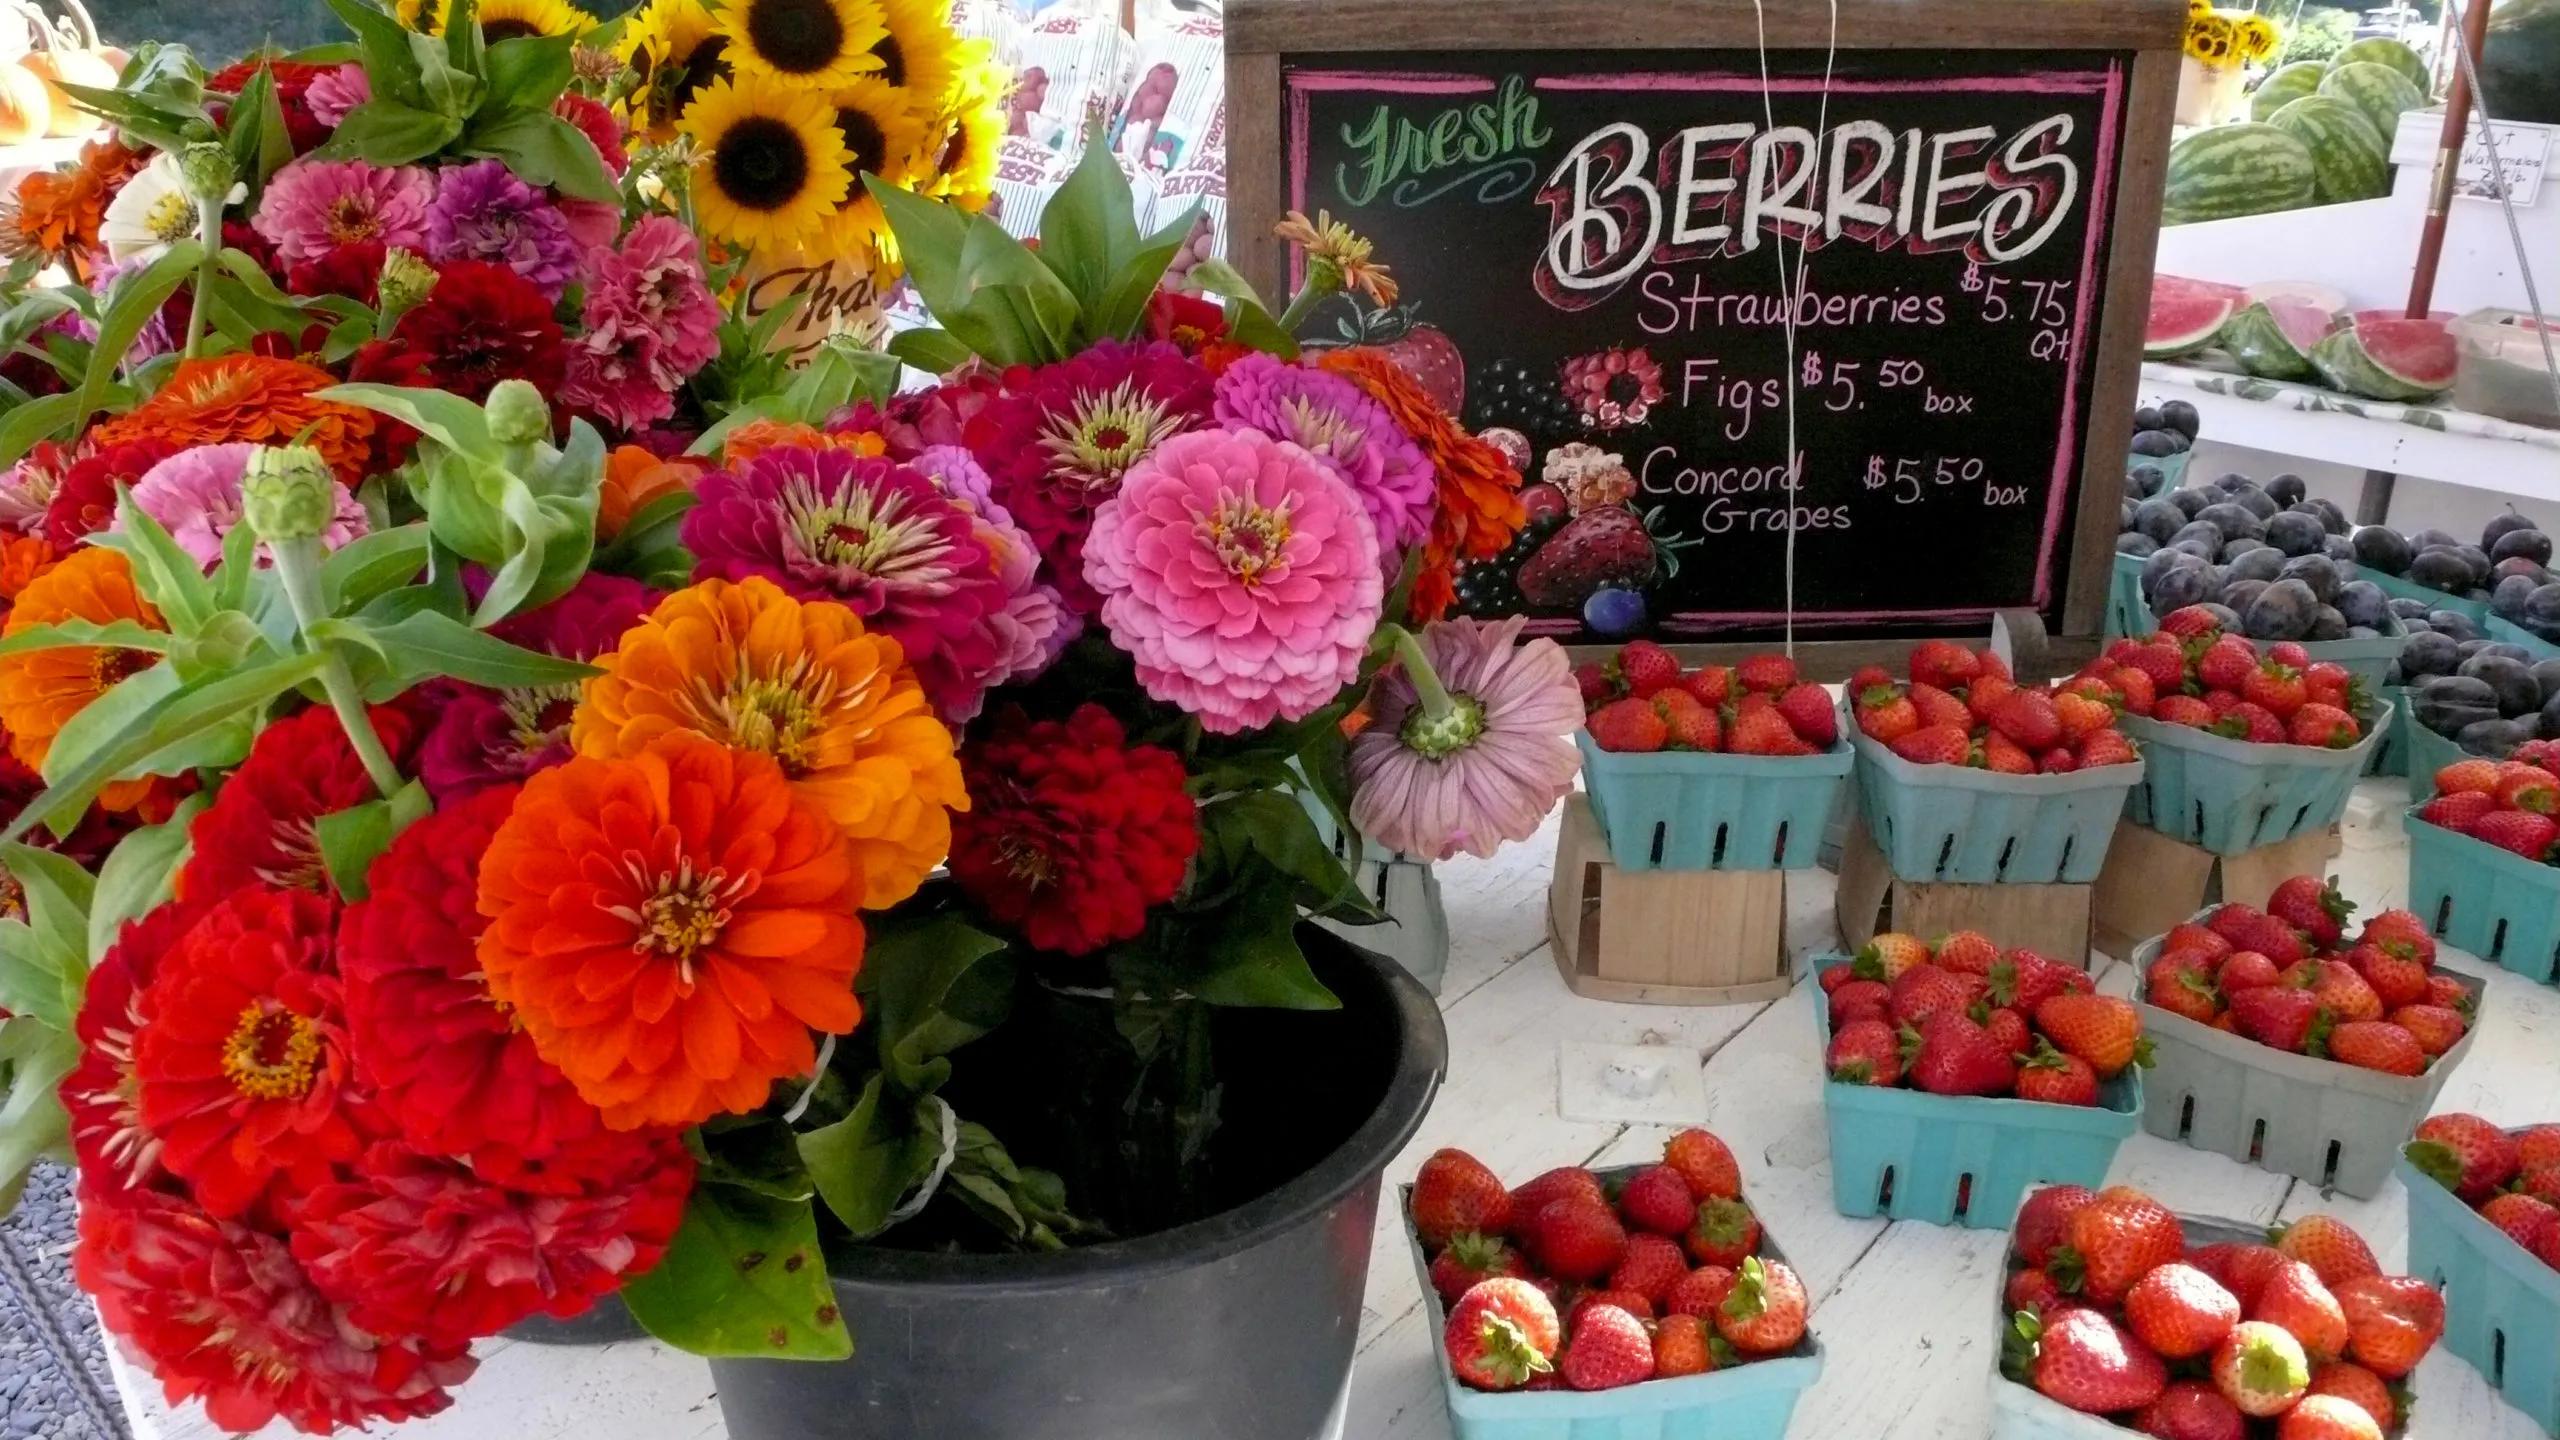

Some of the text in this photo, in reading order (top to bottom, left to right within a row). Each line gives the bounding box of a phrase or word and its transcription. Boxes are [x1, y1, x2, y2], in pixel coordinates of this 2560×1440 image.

[1335, 73, 1553, 207] Fresh
[1546, 112, 2079, 290] BERRIES
[1637, 260, 2072, 334] Strawberries $5.75
[1682, 358, 1781, 441] Figs
[1924, 386, 1974, 413] box
[1640, 446, 1805, 495] Concord
[1983, 479, 2029, 505] box
[1701, 498, 1852, 533] Grapes
